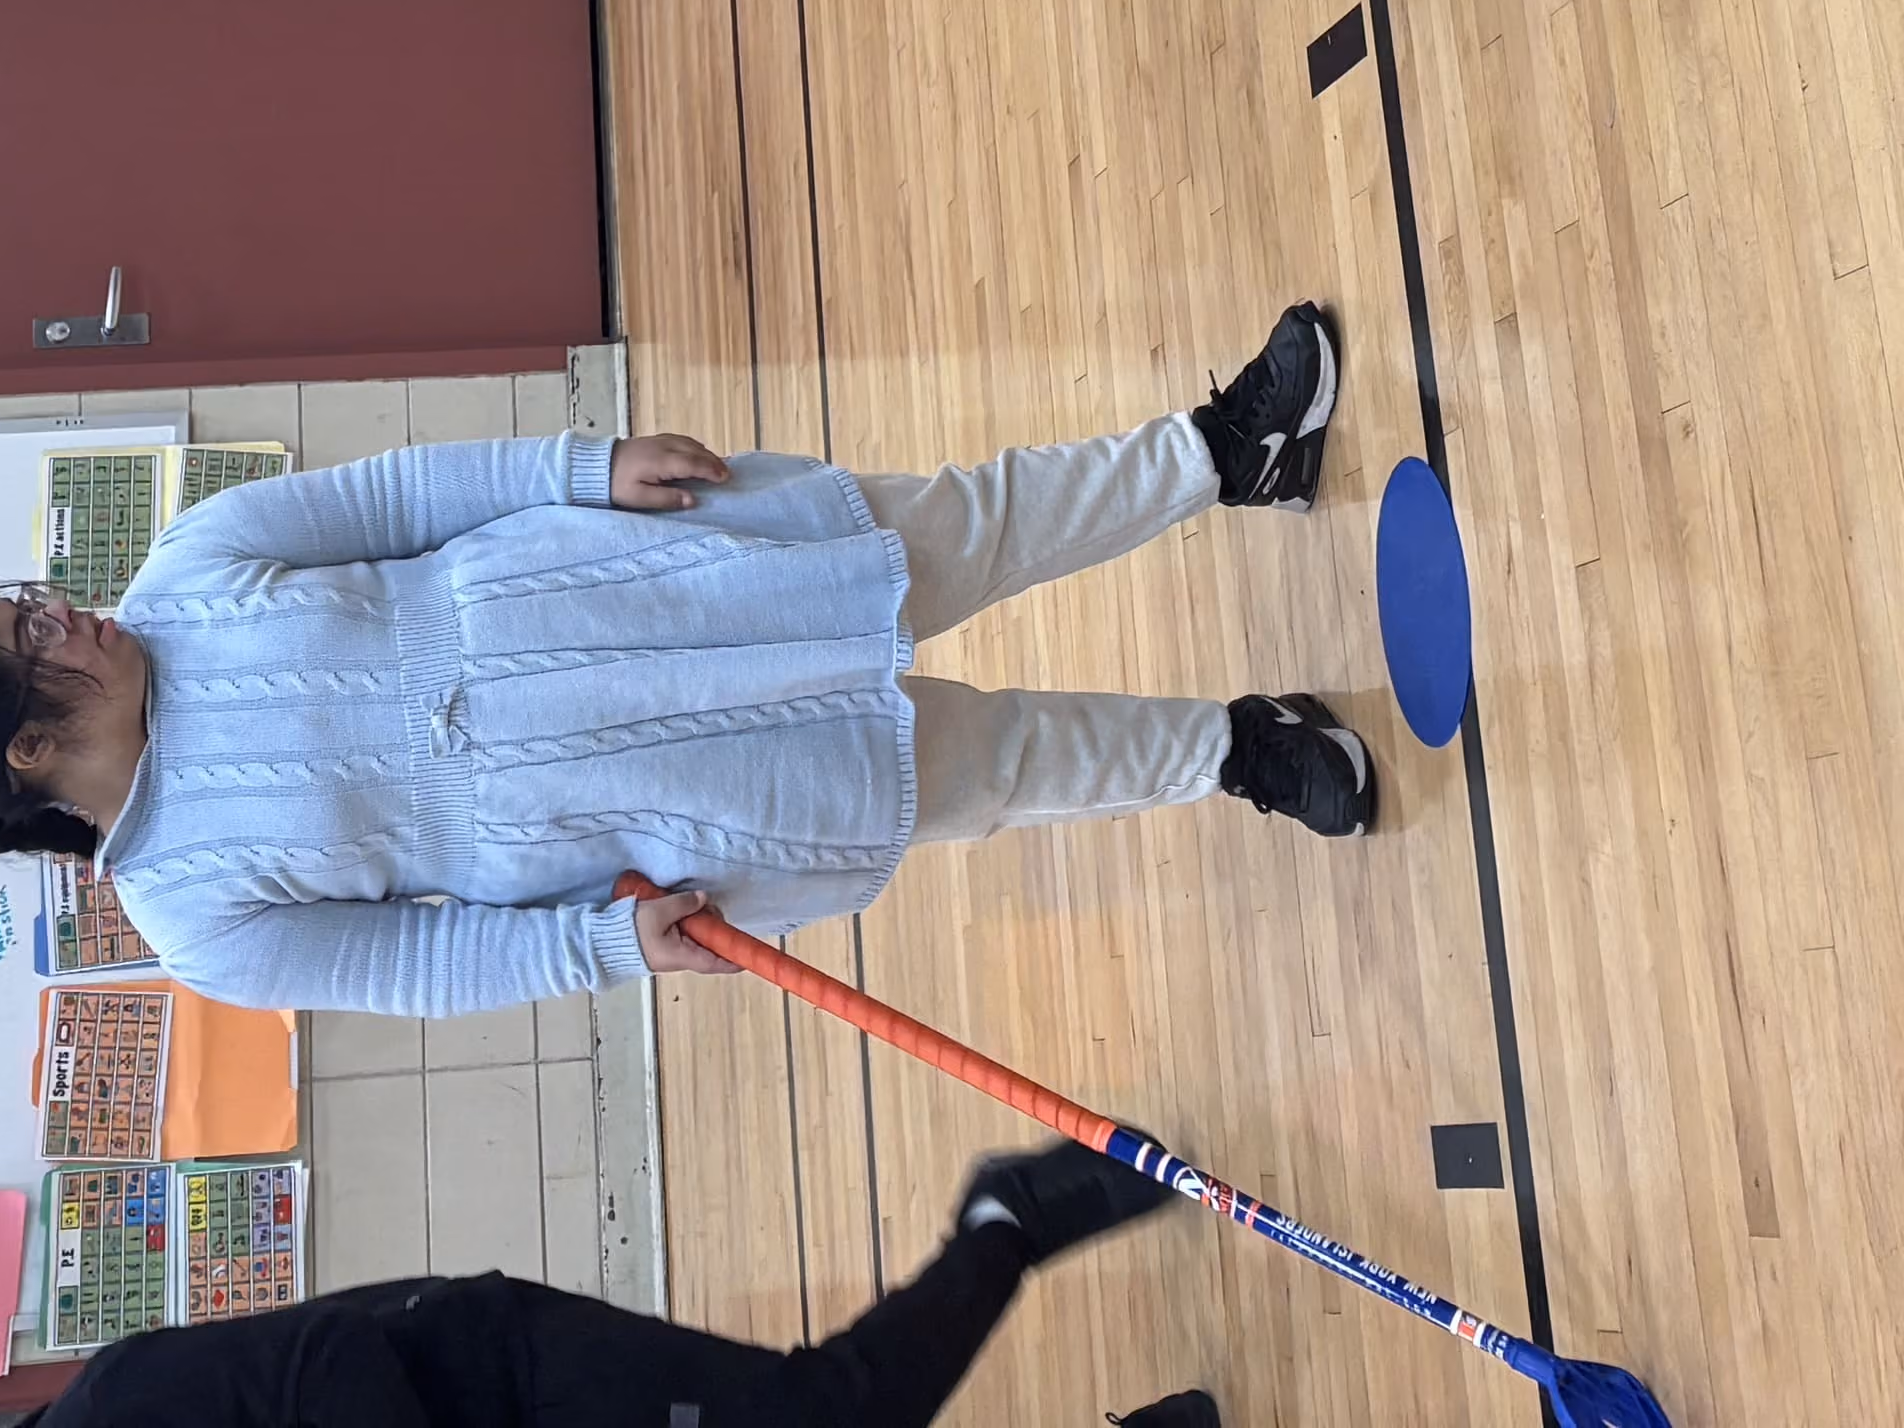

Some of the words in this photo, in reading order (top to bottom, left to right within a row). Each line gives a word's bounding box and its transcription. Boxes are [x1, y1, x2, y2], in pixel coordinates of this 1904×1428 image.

[54, 508, 66, 542] actions
[52, 1051, 70, 1097] Sports
[60, 1248, 76, 1268] P.E
[1404, 1280, 1440, 1304] NEW
